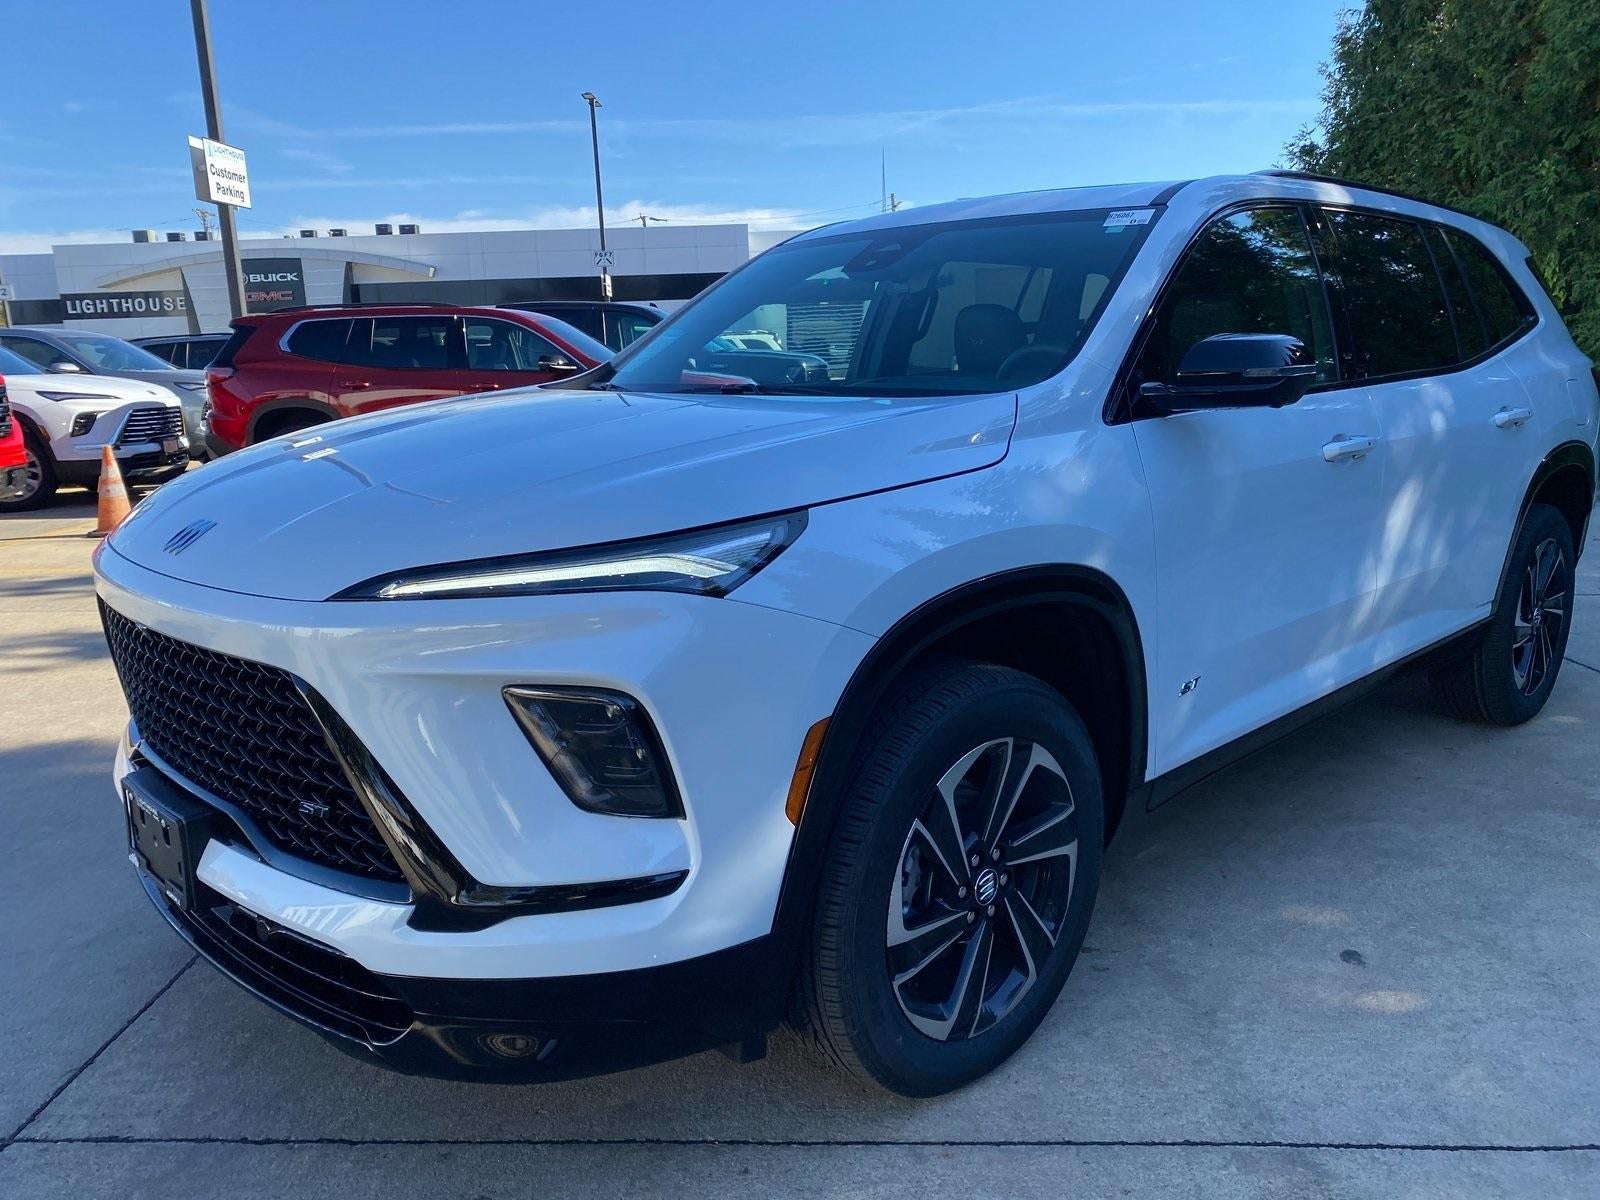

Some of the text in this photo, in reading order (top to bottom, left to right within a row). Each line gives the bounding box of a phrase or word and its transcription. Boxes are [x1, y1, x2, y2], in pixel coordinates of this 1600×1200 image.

[209, 163, 246, 184] Customer
[216, 182, 245, 203] Parking
[249, 272, 299, 283] BUICK
[245, 290, 293, 302] GMC
[65, 297, 187, 314] LIGHTHOUSE
[299, 801, 329, 818] ST
